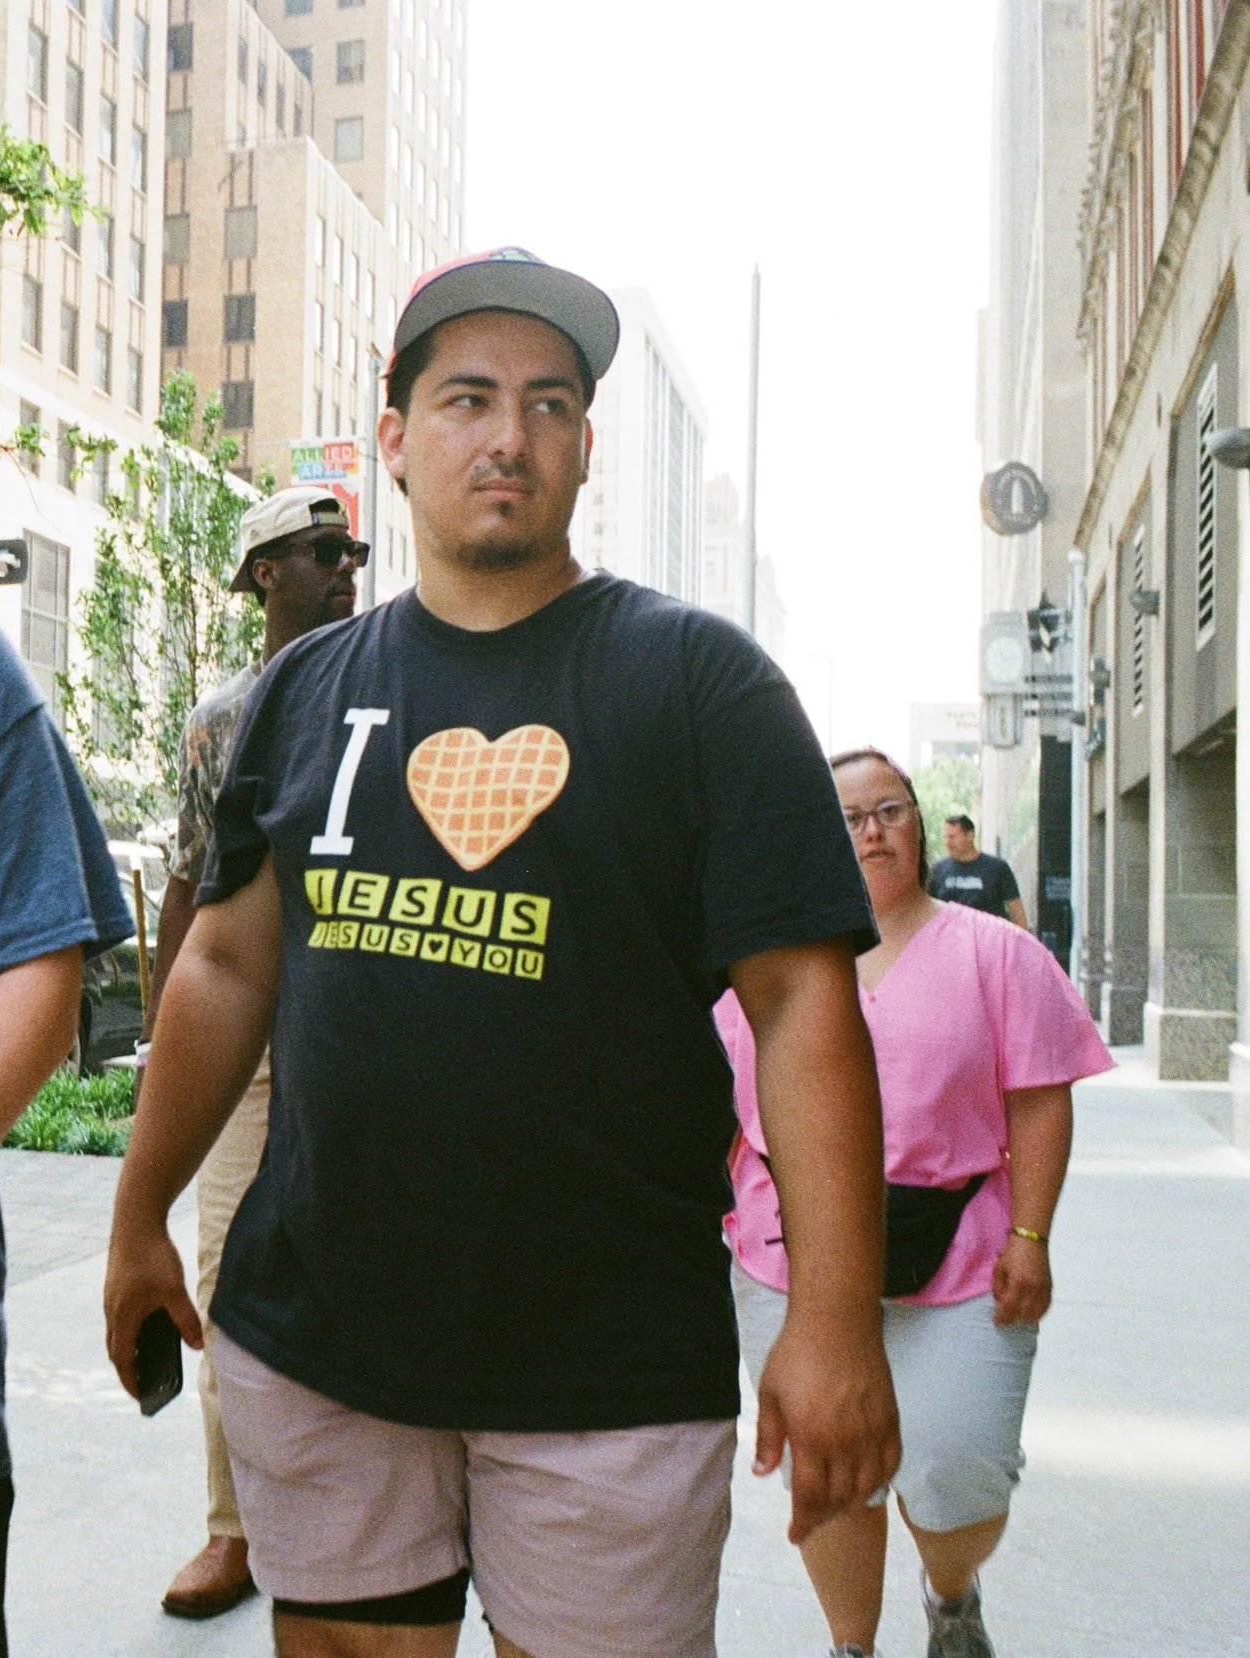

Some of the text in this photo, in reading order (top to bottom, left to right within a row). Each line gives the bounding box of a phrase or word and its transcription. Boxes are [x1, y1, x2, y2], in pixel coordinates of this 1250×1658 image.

[310, 708, 390, 855] I
[313, 874, 540, 938] JESUS
[312, 923, 540, 974] JESUS YOU
